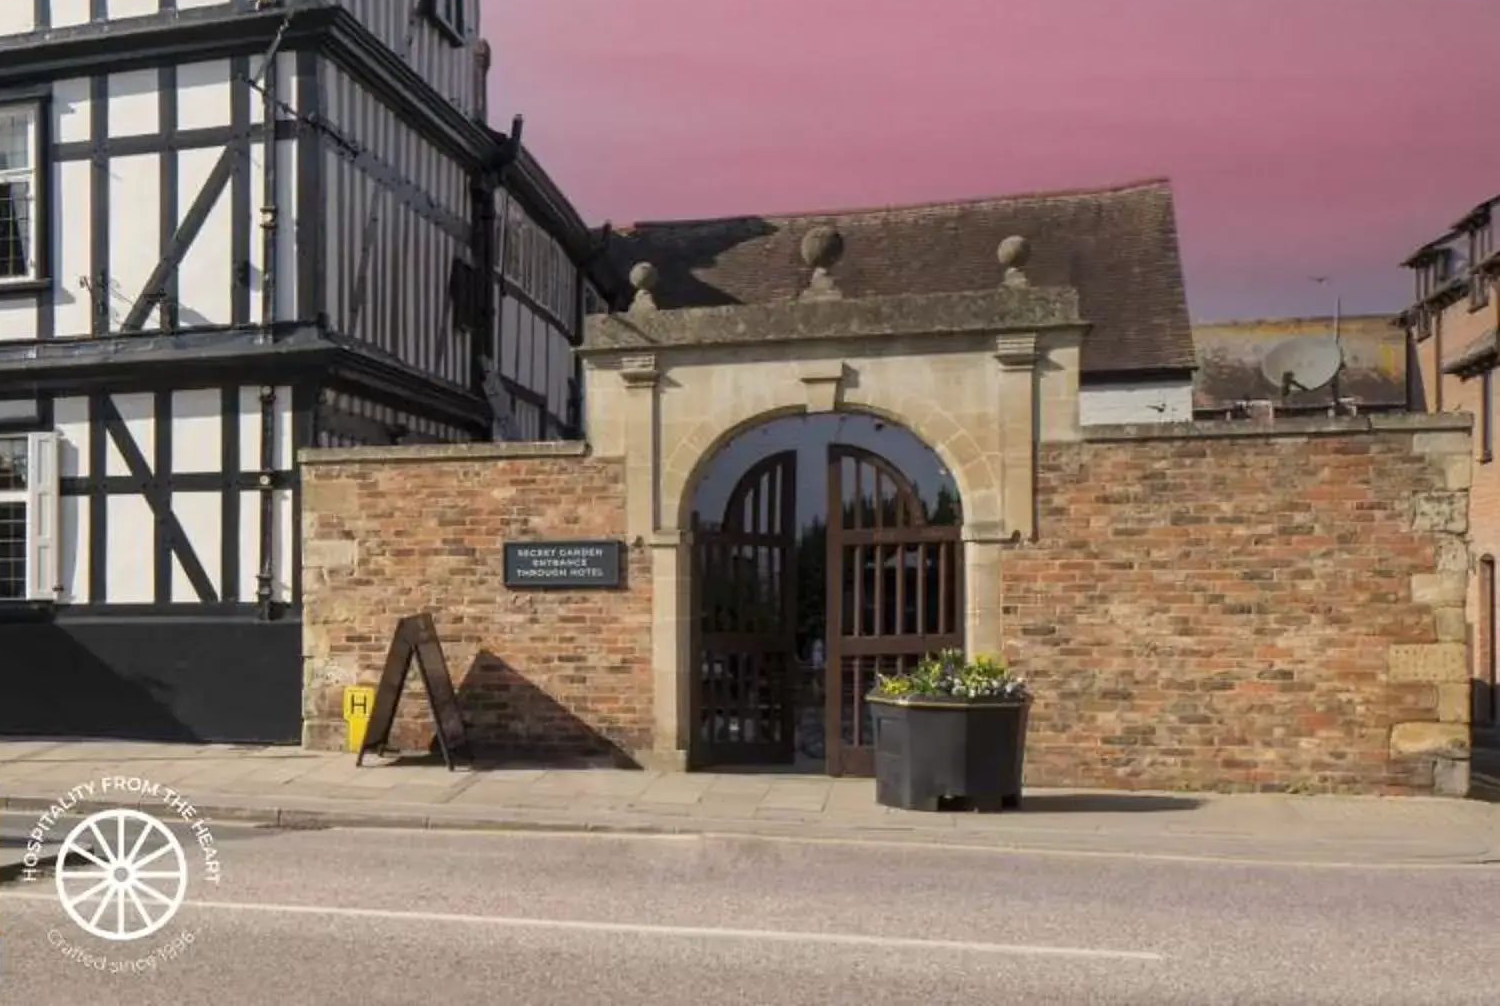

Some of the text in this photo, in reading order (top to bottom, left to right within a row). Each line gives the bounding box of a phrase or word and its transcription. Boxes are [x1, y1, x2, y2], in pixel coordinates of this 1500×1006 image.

[517, 548, 603, 557] SECRET GARDEN
[532, 559, 587, 567] ENTRANCE
[516, 568, 603, 577] THROUGH HOTEL
[351, 694, 367, 714] H
